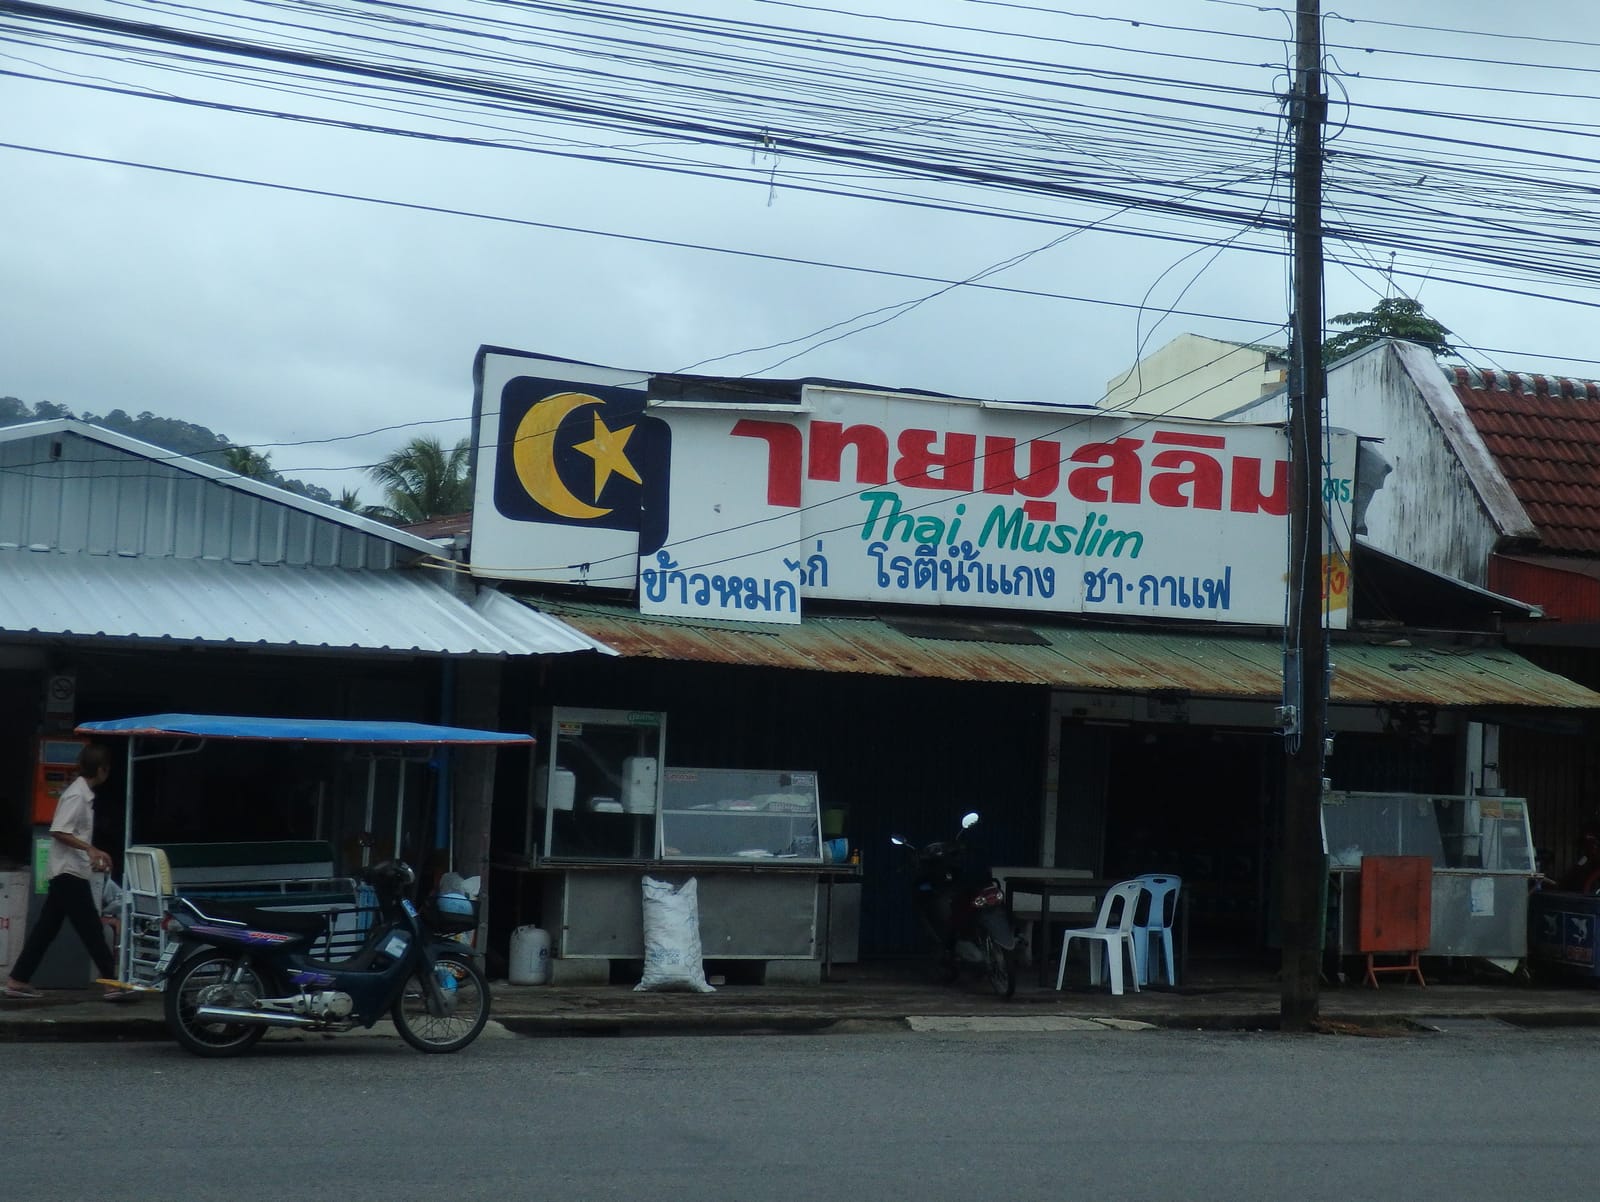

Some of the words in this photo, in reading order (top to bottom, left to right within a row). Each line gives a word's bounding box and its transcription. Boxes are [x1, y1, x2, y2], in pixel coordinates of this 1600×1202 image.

[858, 491, 971, 546] Thai
[977, 501, 1144, 560] Muslim
[868, 541, 1055, 599] โรตีน้ำแกง
